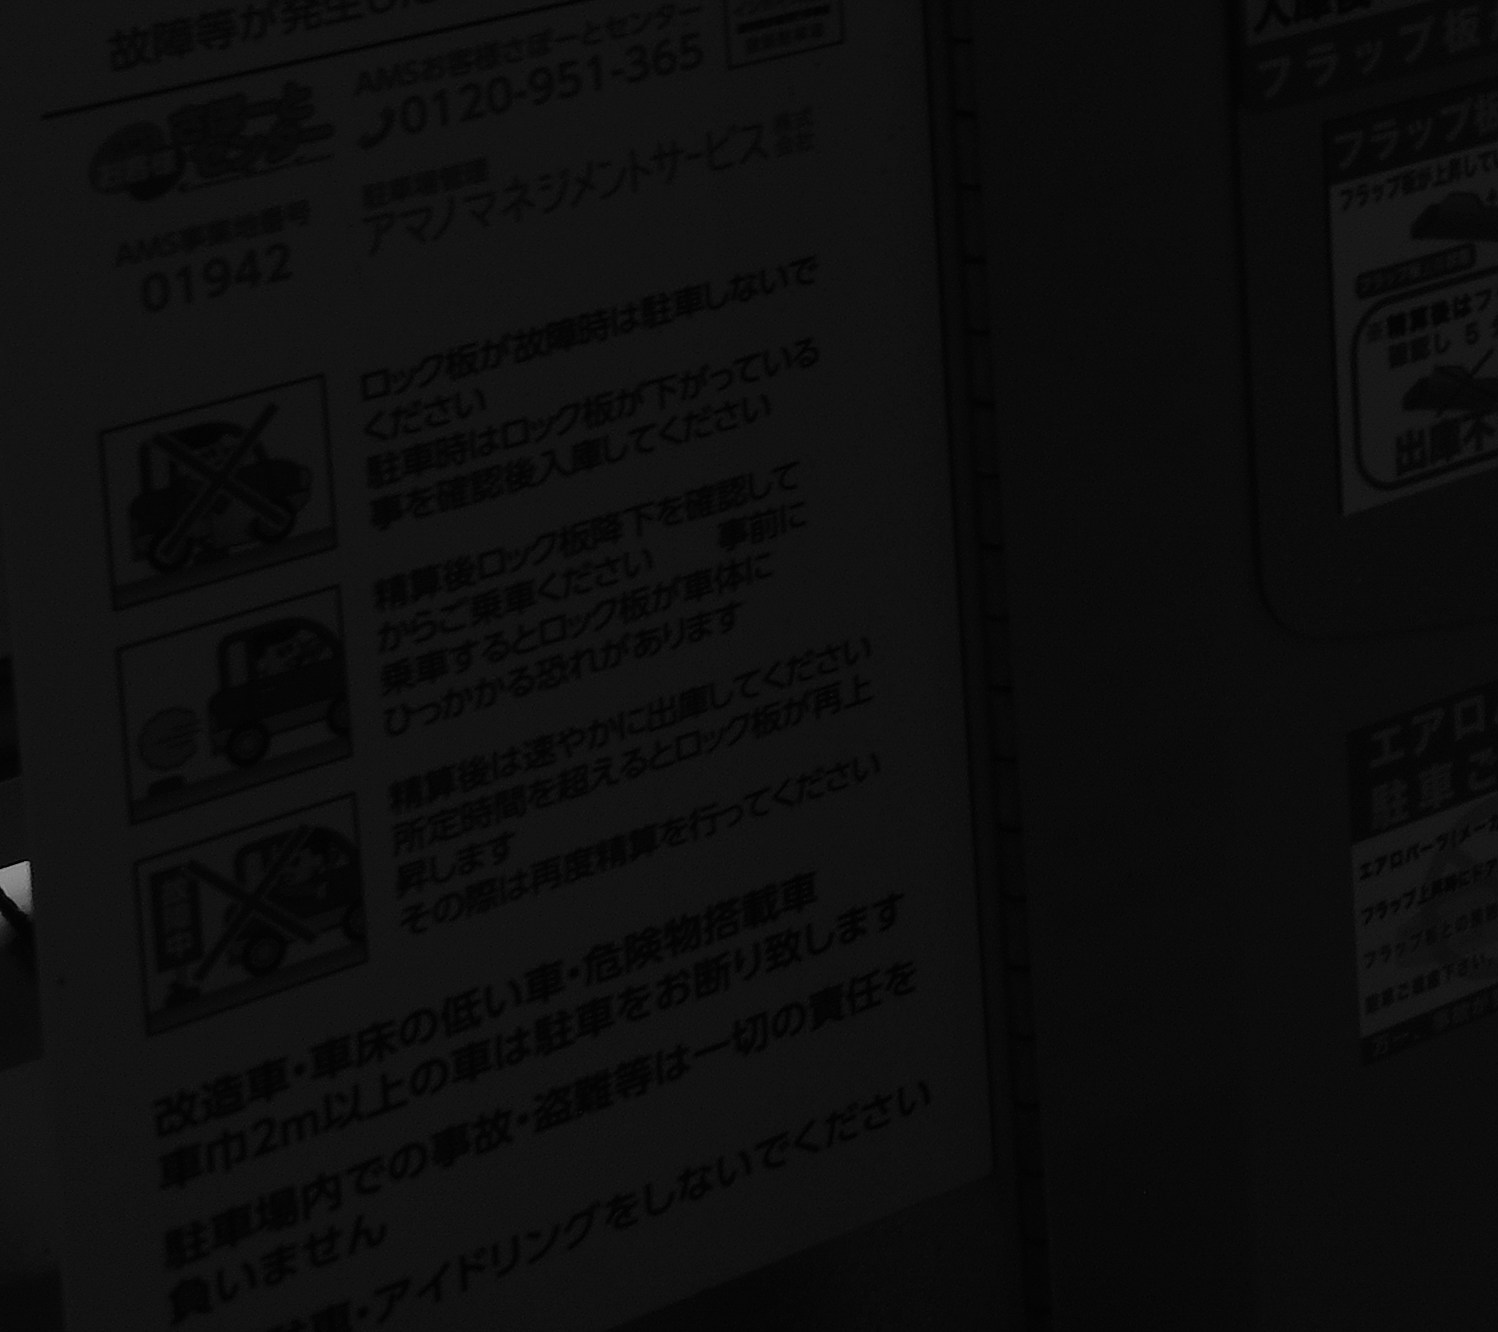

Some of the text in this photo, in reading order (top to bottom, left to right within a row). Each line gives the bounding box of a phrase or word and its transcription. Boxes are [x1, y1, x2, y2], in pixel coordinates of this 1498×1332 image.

[400, 31, 706, 137] 0120-951-365
[139, 243, 295, 314] 01942
[359, 253, 818, 402] ロック板が故障時は駐車しないで
[363, 387, 488, 440] ください
[365, 336, 821, 489] 駐車時はロック板が下がっている
[369, 392, 773, 531] 事を確認後入庫してください
[379, 551, 774, 696] 乗車するとロック板が車体に
[383, 601, 743, 737] ひっかかる恐れがあります
[397, 831, 517, 896] 昇します
[400, 752, 883, 936] その際は再度精算を行ってください
[153, 871, 819, 1139] 改造車・車床の低い車・危険物搭載車
[163, 959, 919, 1272] 駐車場内での事故・盗難等は一切の責任を
[168, 1217, 389, 1328] 負いません
[266, 1078, 934, 1332] 車・アイドリングをしないでください
